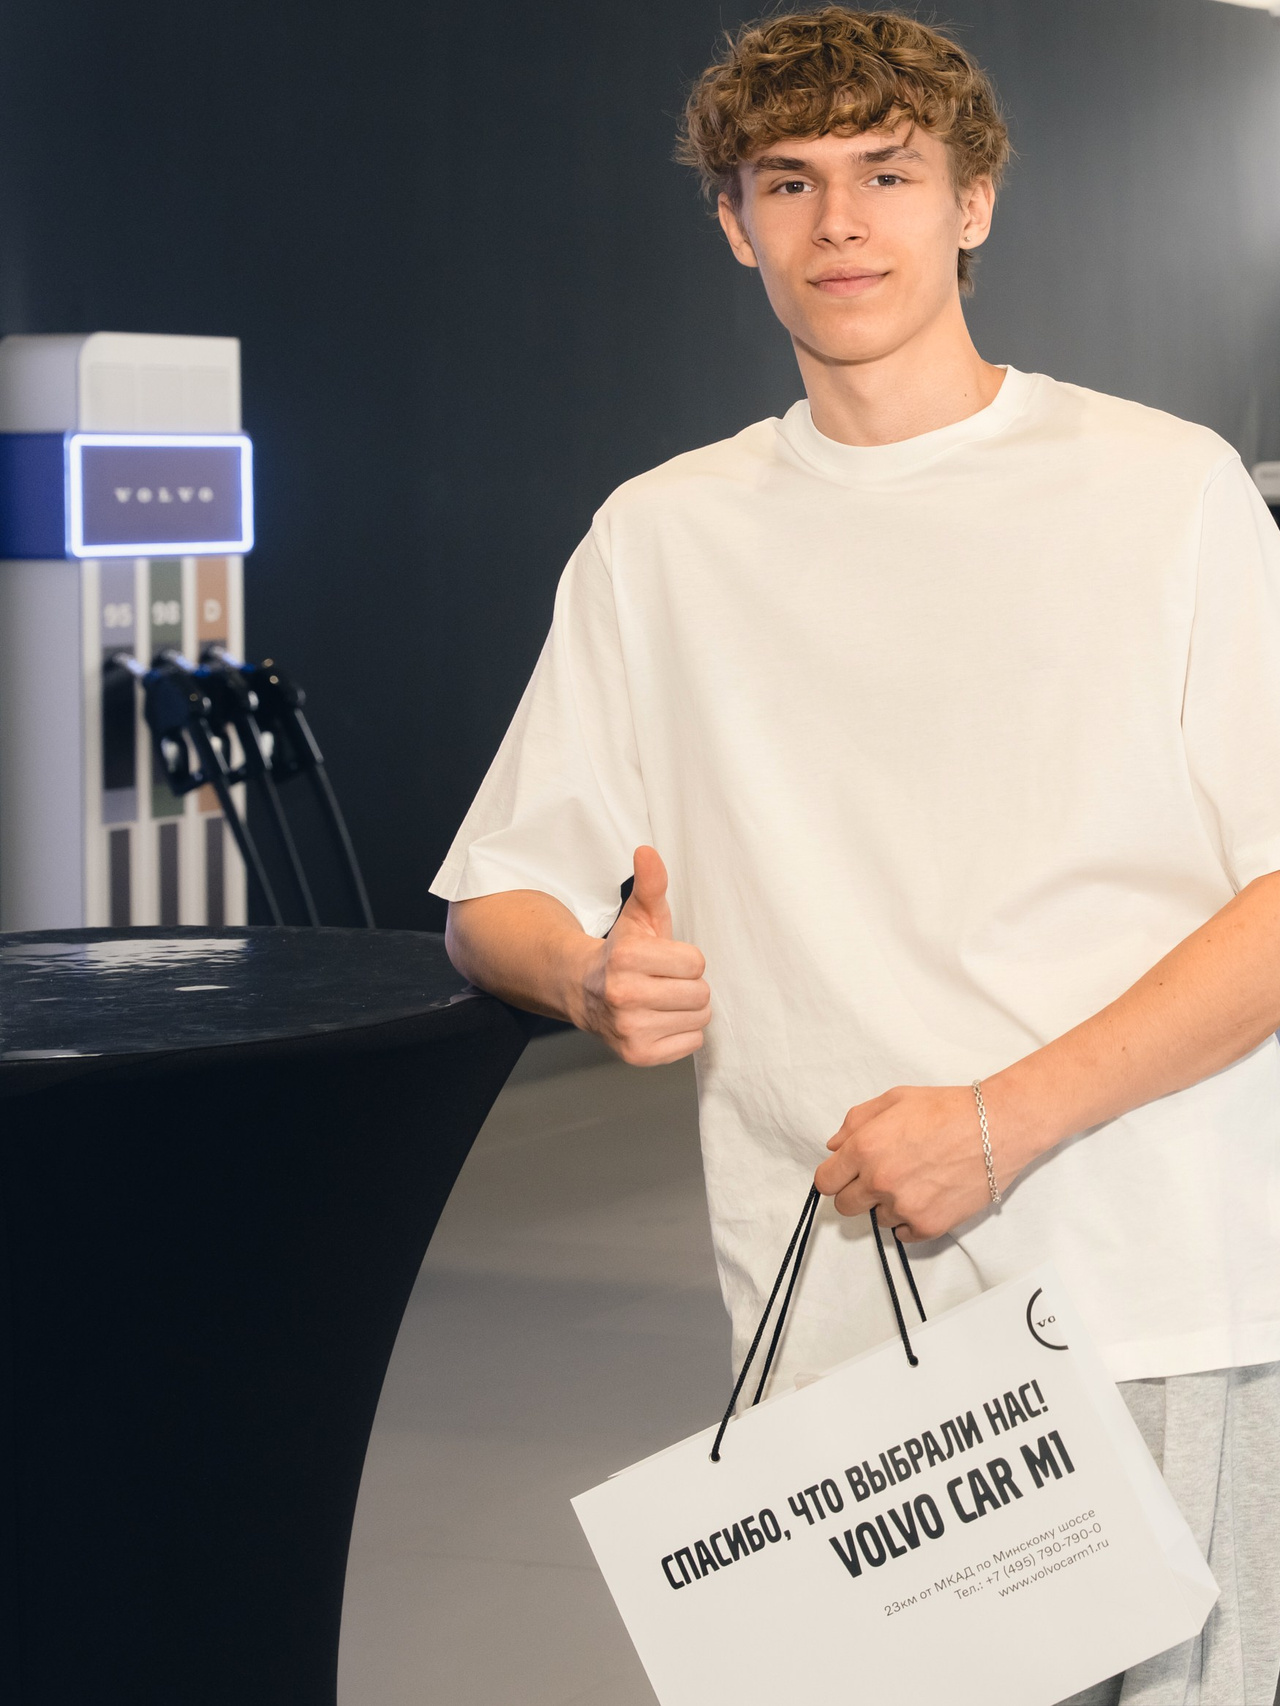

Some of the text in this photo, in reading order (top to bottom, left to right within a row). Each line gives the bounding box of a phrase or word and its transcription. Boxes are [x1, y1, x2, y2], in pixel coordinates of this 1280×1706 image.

[115, 486, 214, 503] VOLVO
[103, 601, 133, 629] 95
[151, 600, 181, 626] 98
[203, 599, 222, 624] D
[661, 1379, 1049, 1591] СПАСИБО, ЧТО ВЫБРАЛИ НАС!
[829, 1430, 1076, 1579] VOLVO CAR M1
[884, 1509, 1096, 1617] 23км от МКАД по Минскому шоссе
[954, 1522, 1102, 1600] Тел.: +7 (495) 790-790-0
[997, 1538, 1110, 1598] www.volvocarm1.ru
